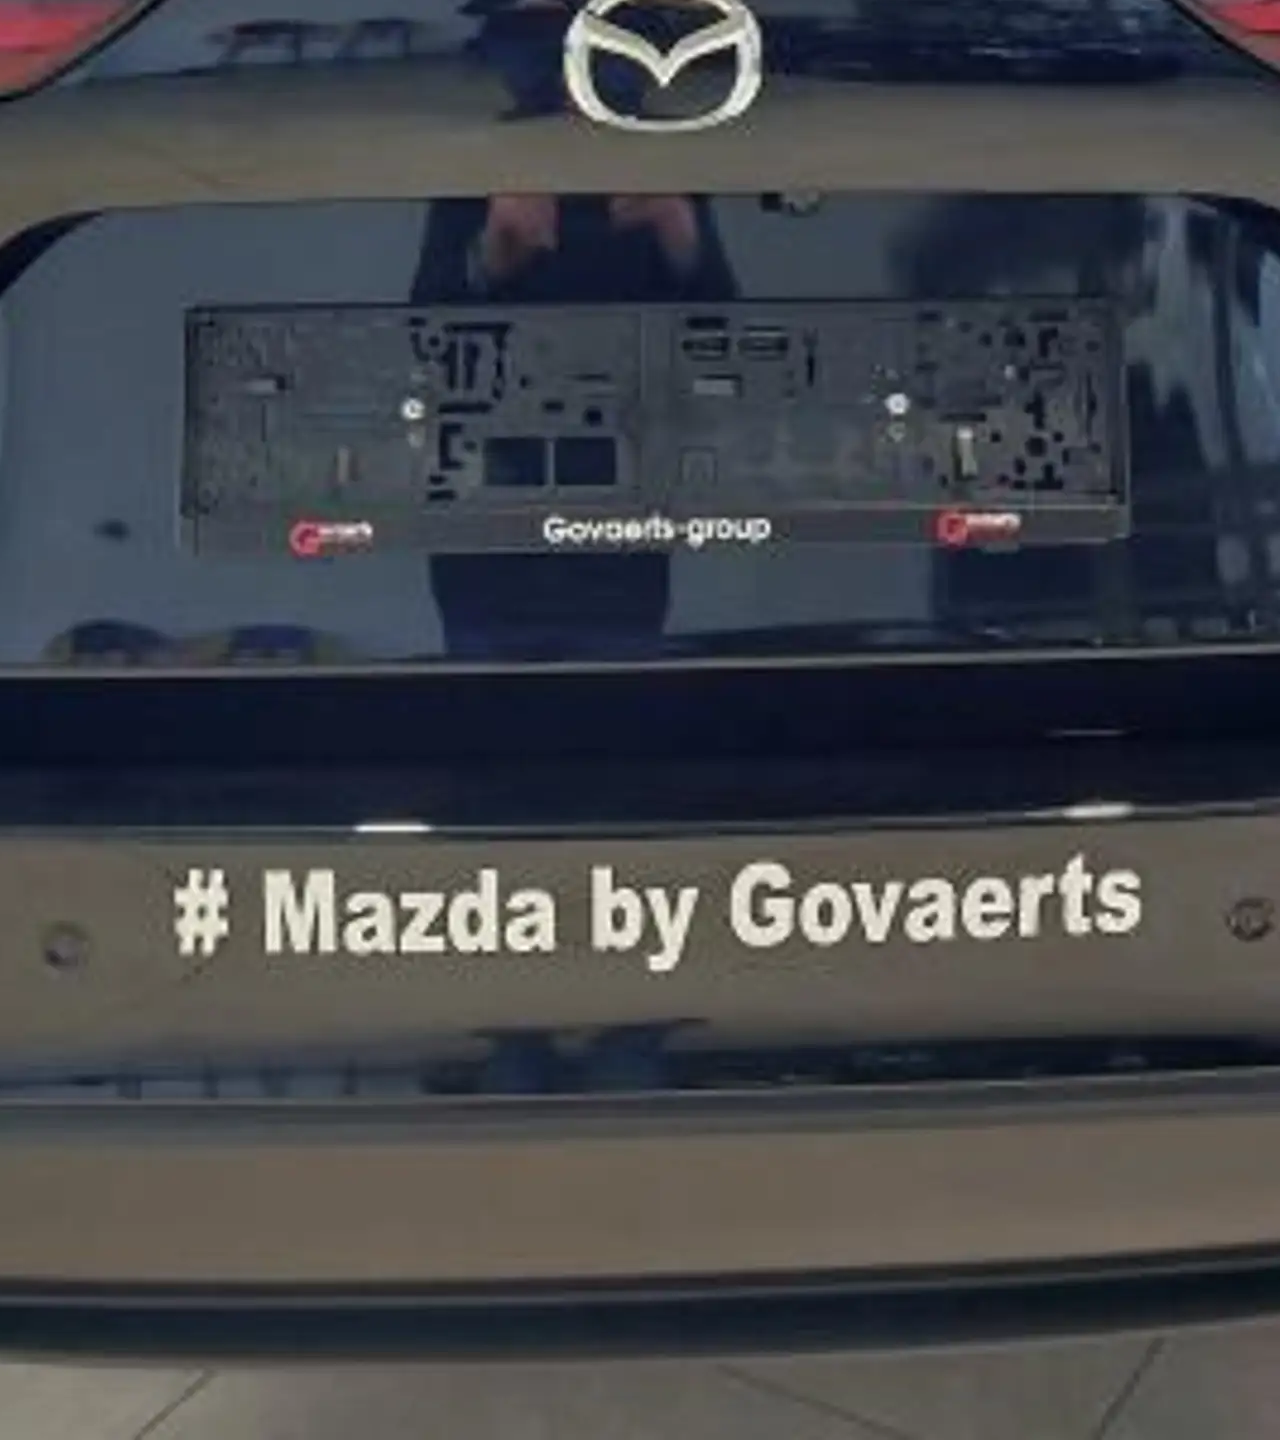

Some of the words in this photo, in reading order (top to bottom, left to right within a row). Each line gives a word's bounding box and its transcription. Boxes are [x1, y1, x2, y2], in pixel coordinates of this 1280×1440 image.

[173, 867, 230, 956] #
[263, 868, 558, 955] Mazda
[590, 865, 699, 971] by
[728, 852, 1143, 948] Govaerts
